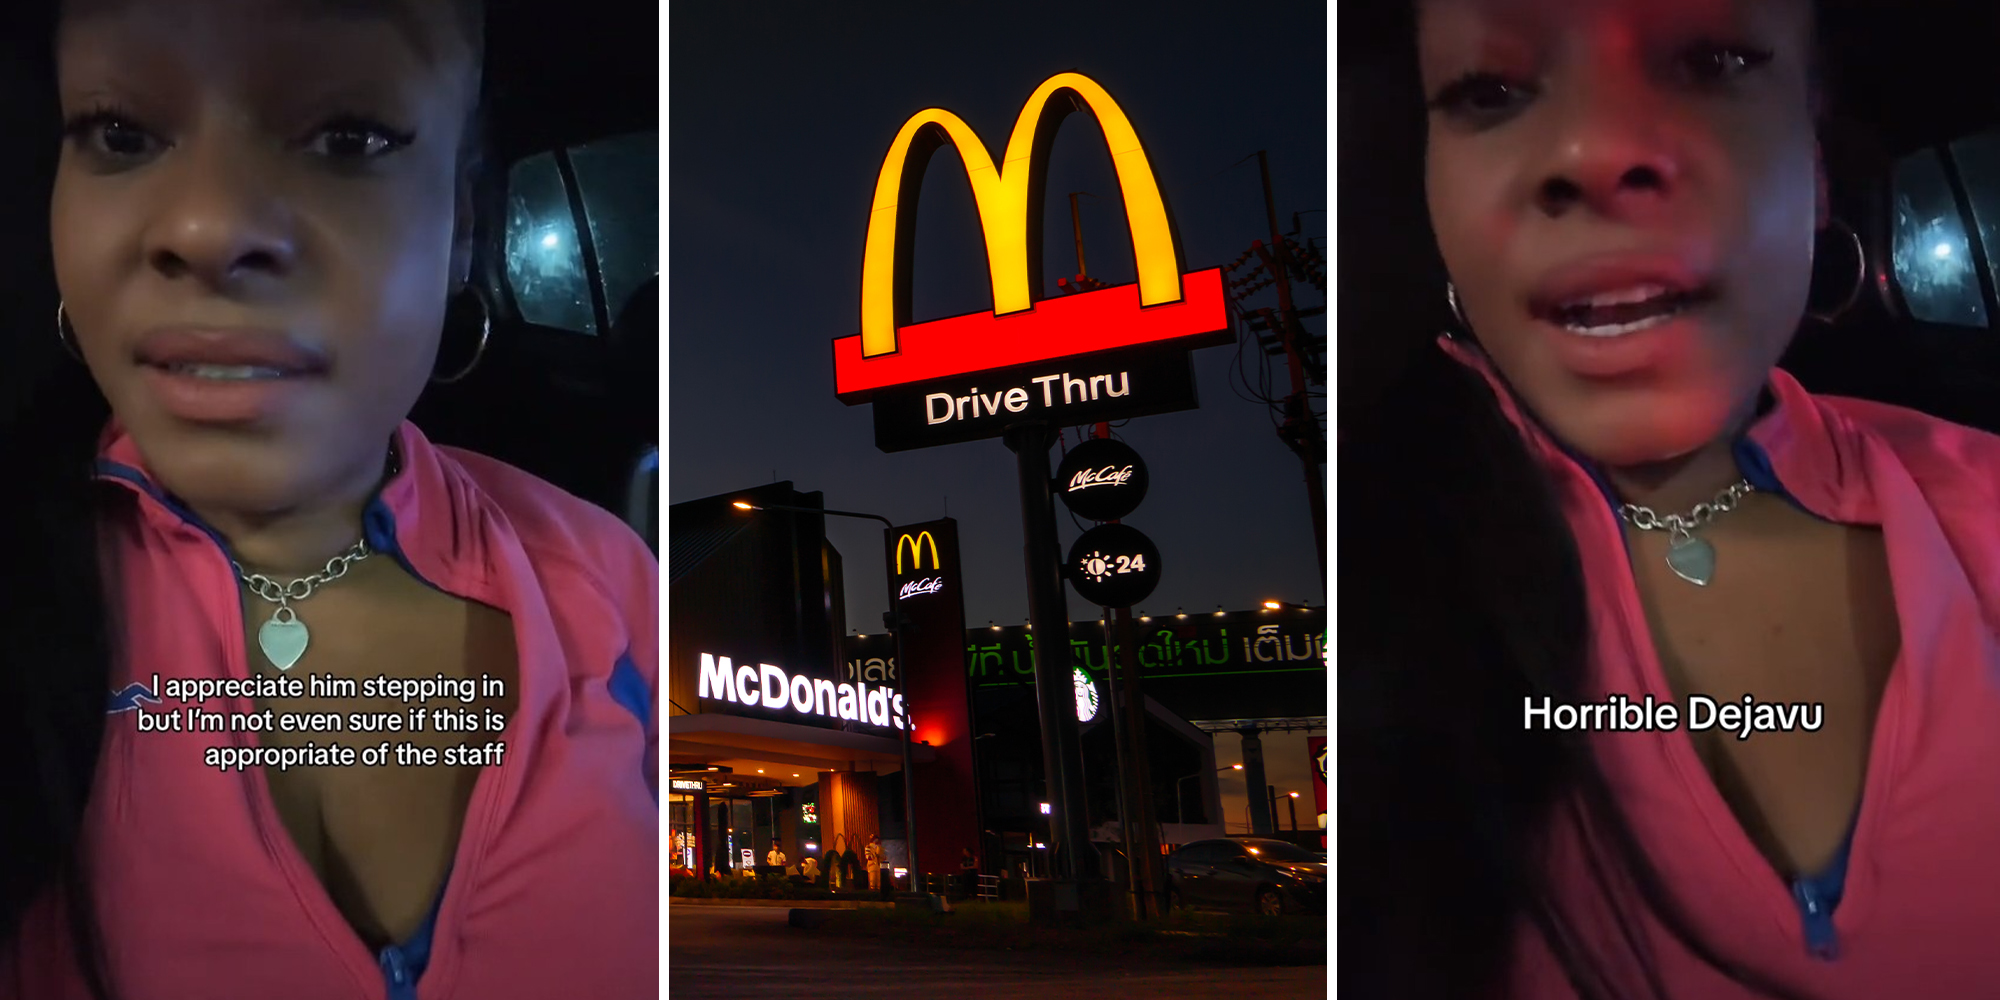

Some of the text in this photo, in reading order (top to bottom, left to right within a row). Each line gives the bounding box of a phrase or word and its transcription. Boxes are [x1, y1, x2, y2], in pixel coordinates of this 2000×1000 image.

[925, 371, 1130, 425] Drive Thru
[1115, 554, 1146, 574] 24
[698, 652, 912, 731] McDonald's
